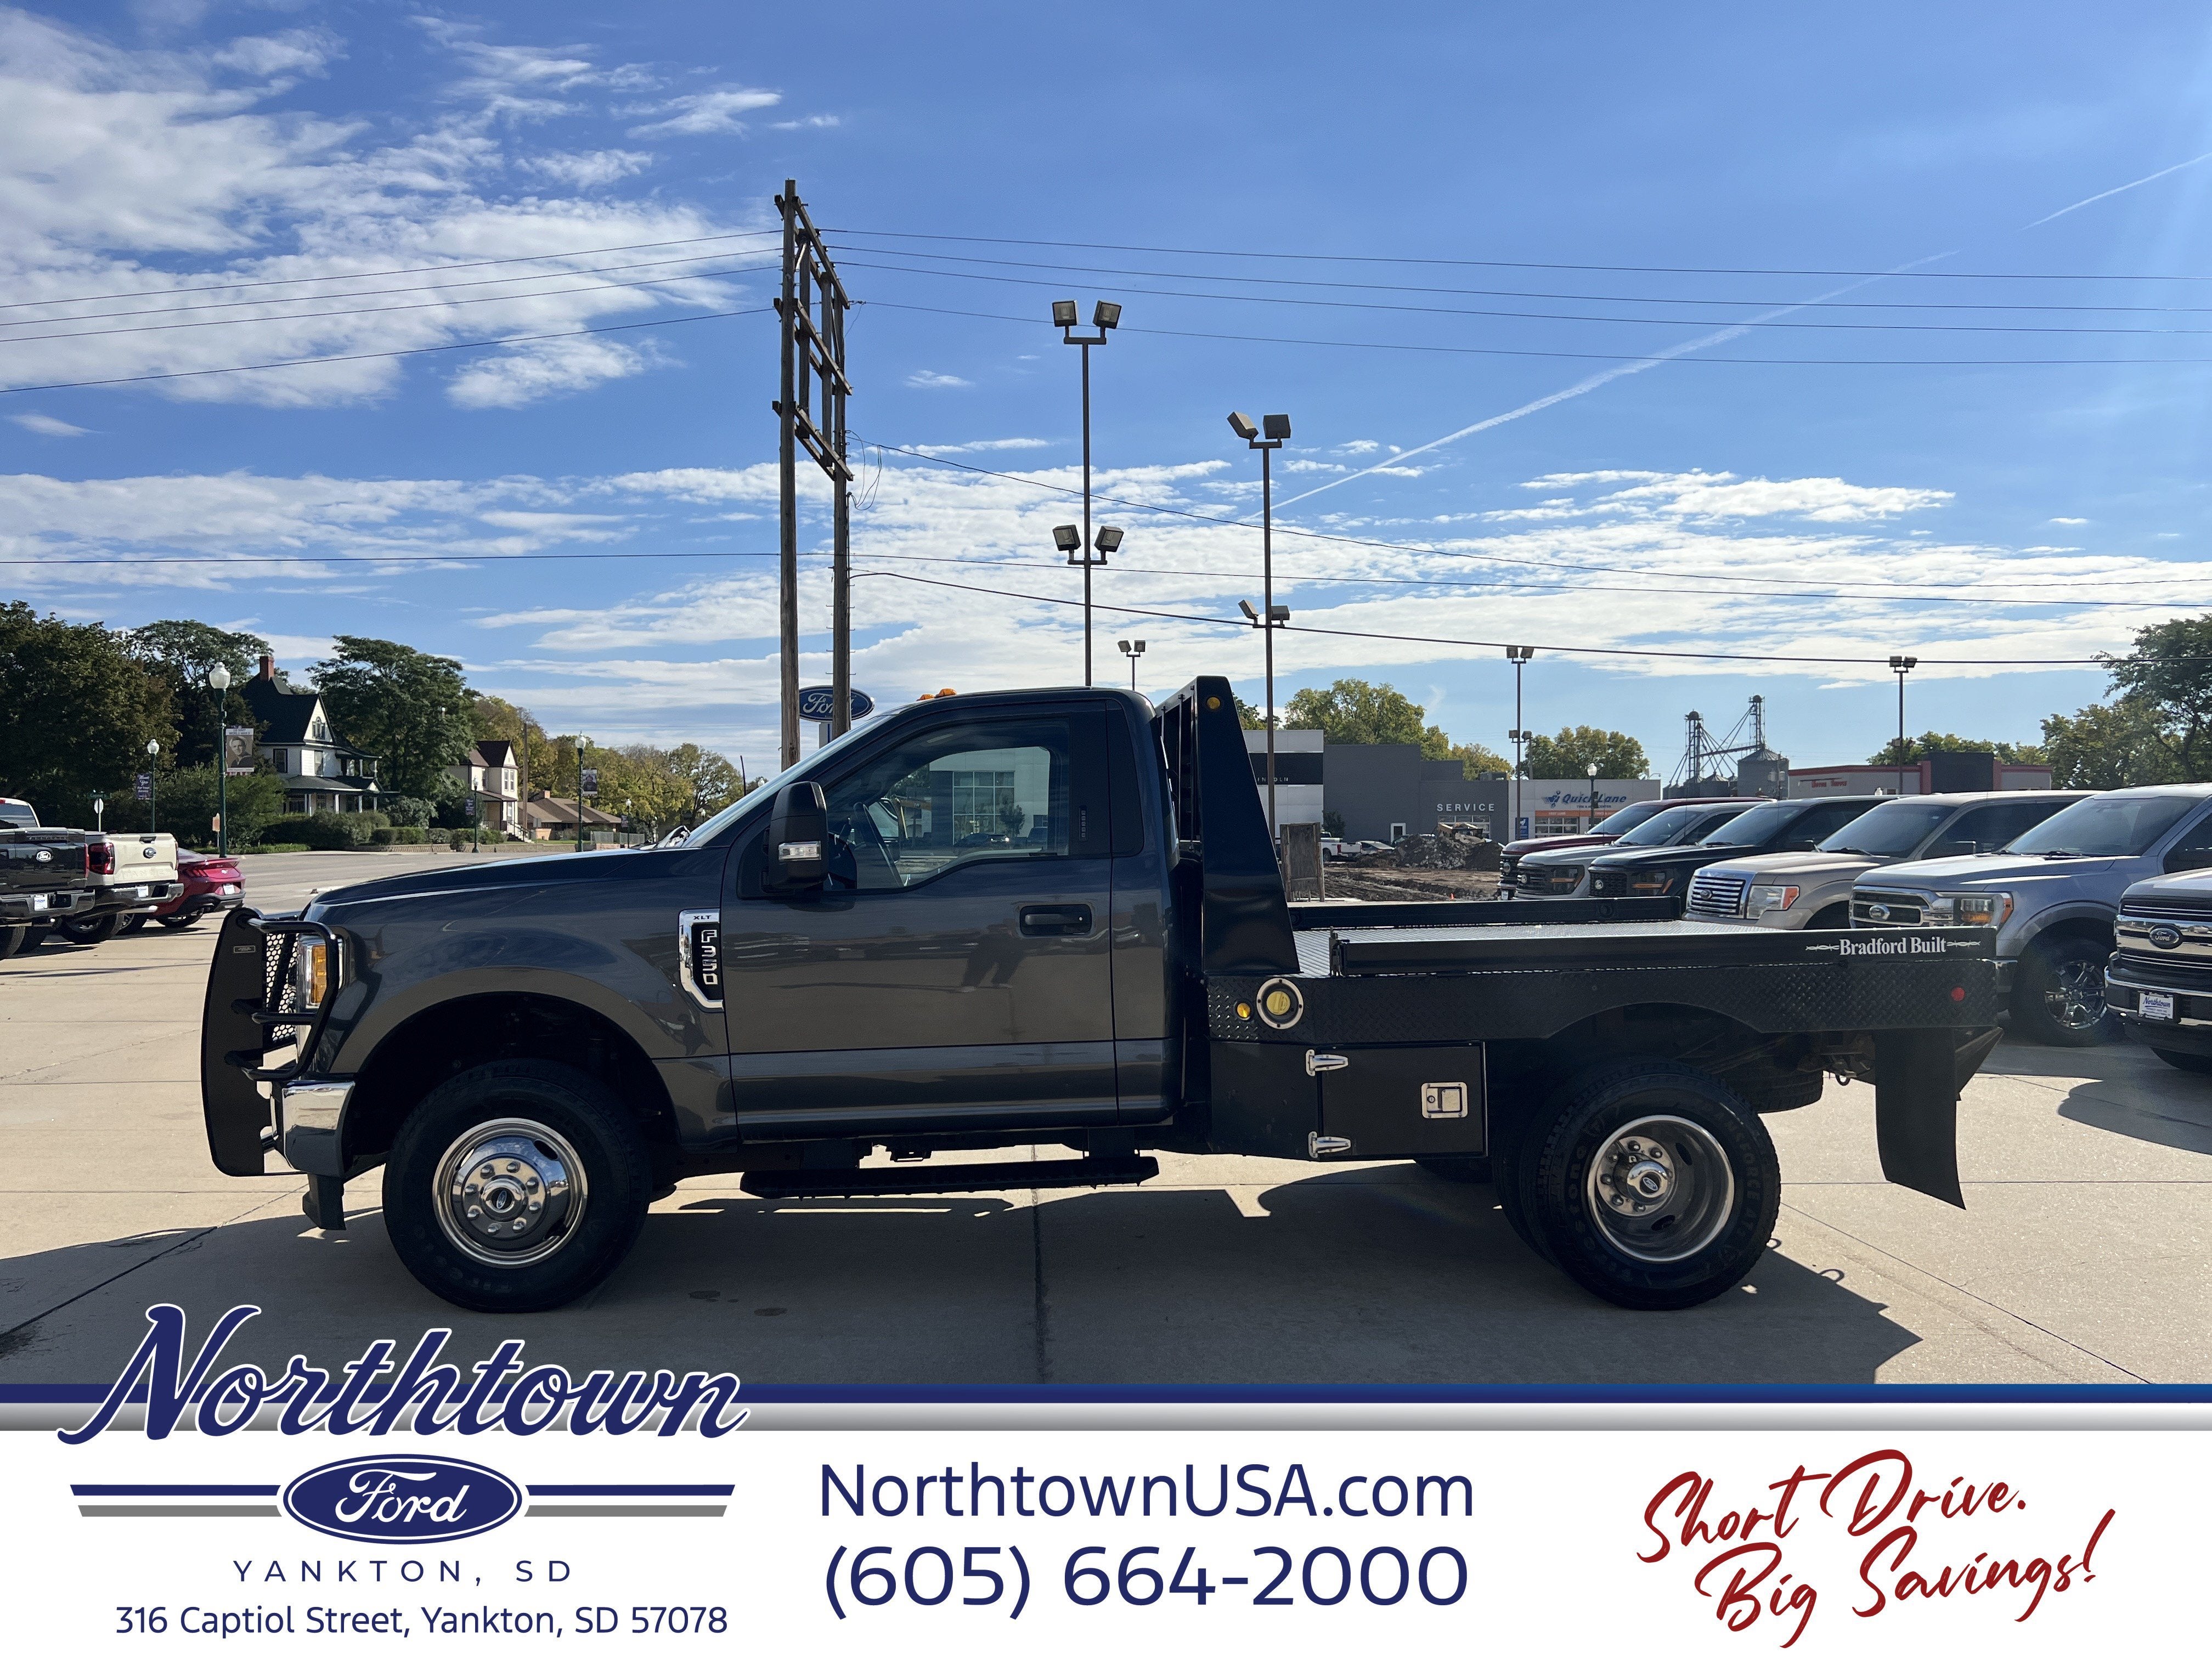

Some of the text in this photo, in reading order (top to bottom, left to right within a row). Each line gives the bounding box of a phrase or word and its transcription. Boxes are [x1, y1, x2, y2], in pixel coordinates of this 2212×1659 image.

[803, 692, 854, 714] Fo
[1598, 794, 1627, 803] Lane
[1436, 803, 1495, 812] SERVICE
[2154, 931, 2171, 942] Ford
[1839, 936, 1946, 956] Bradford Built
[2142, 996, 2171, 1008] Northtown
